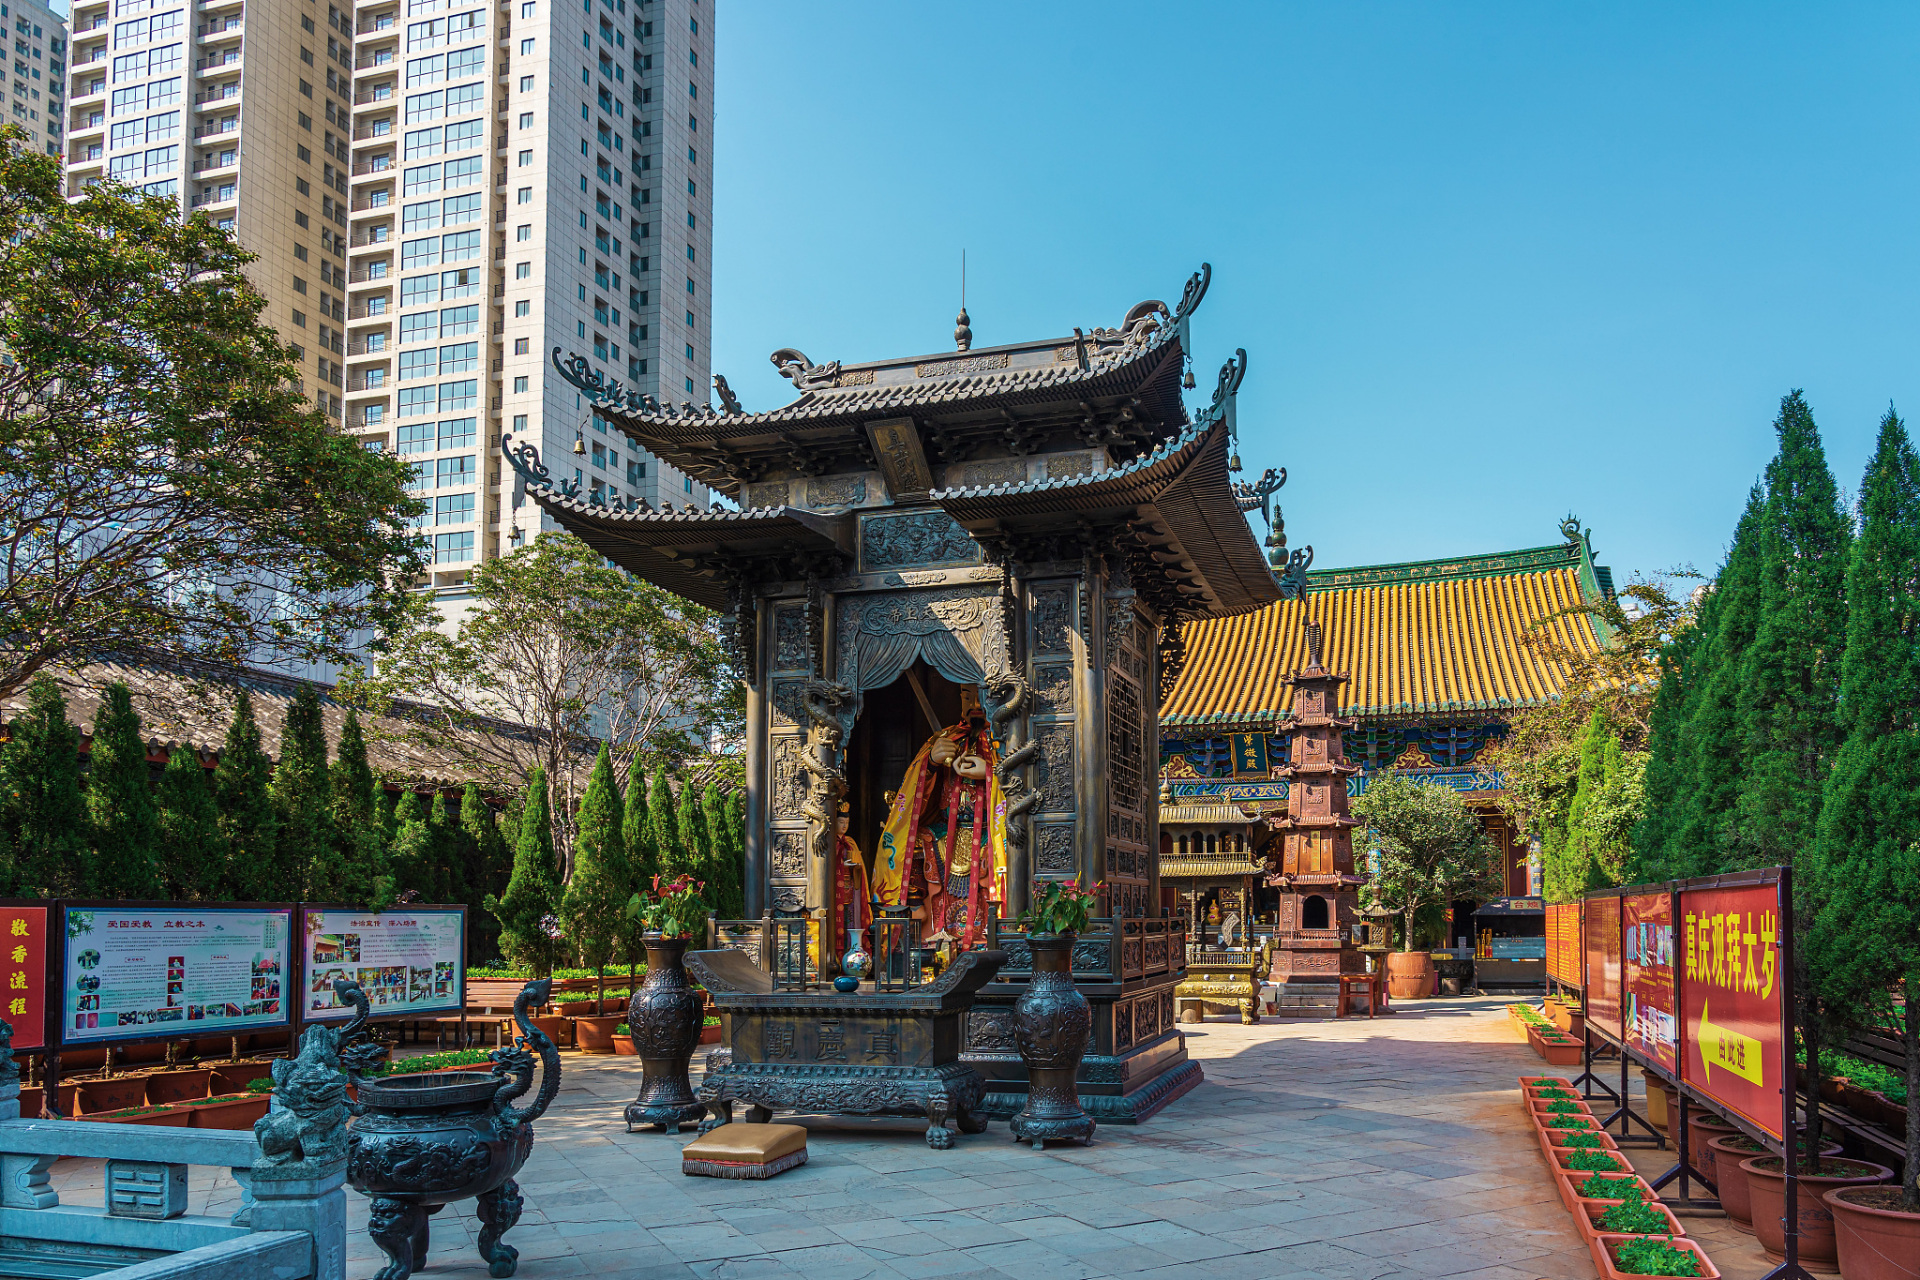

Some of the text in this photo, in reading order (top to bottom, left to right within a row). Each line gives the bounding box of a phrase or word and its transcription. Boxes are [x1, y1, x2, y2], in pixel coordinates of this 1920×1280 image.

[1243, 733, 1258, 770] 紫微殿
[8, 918, 30, 1016] 敬香流程
[1685, 909, 1776, 1000] 真庆观拜太岁
[1719, 1031, 1746, 1071] 由此进
